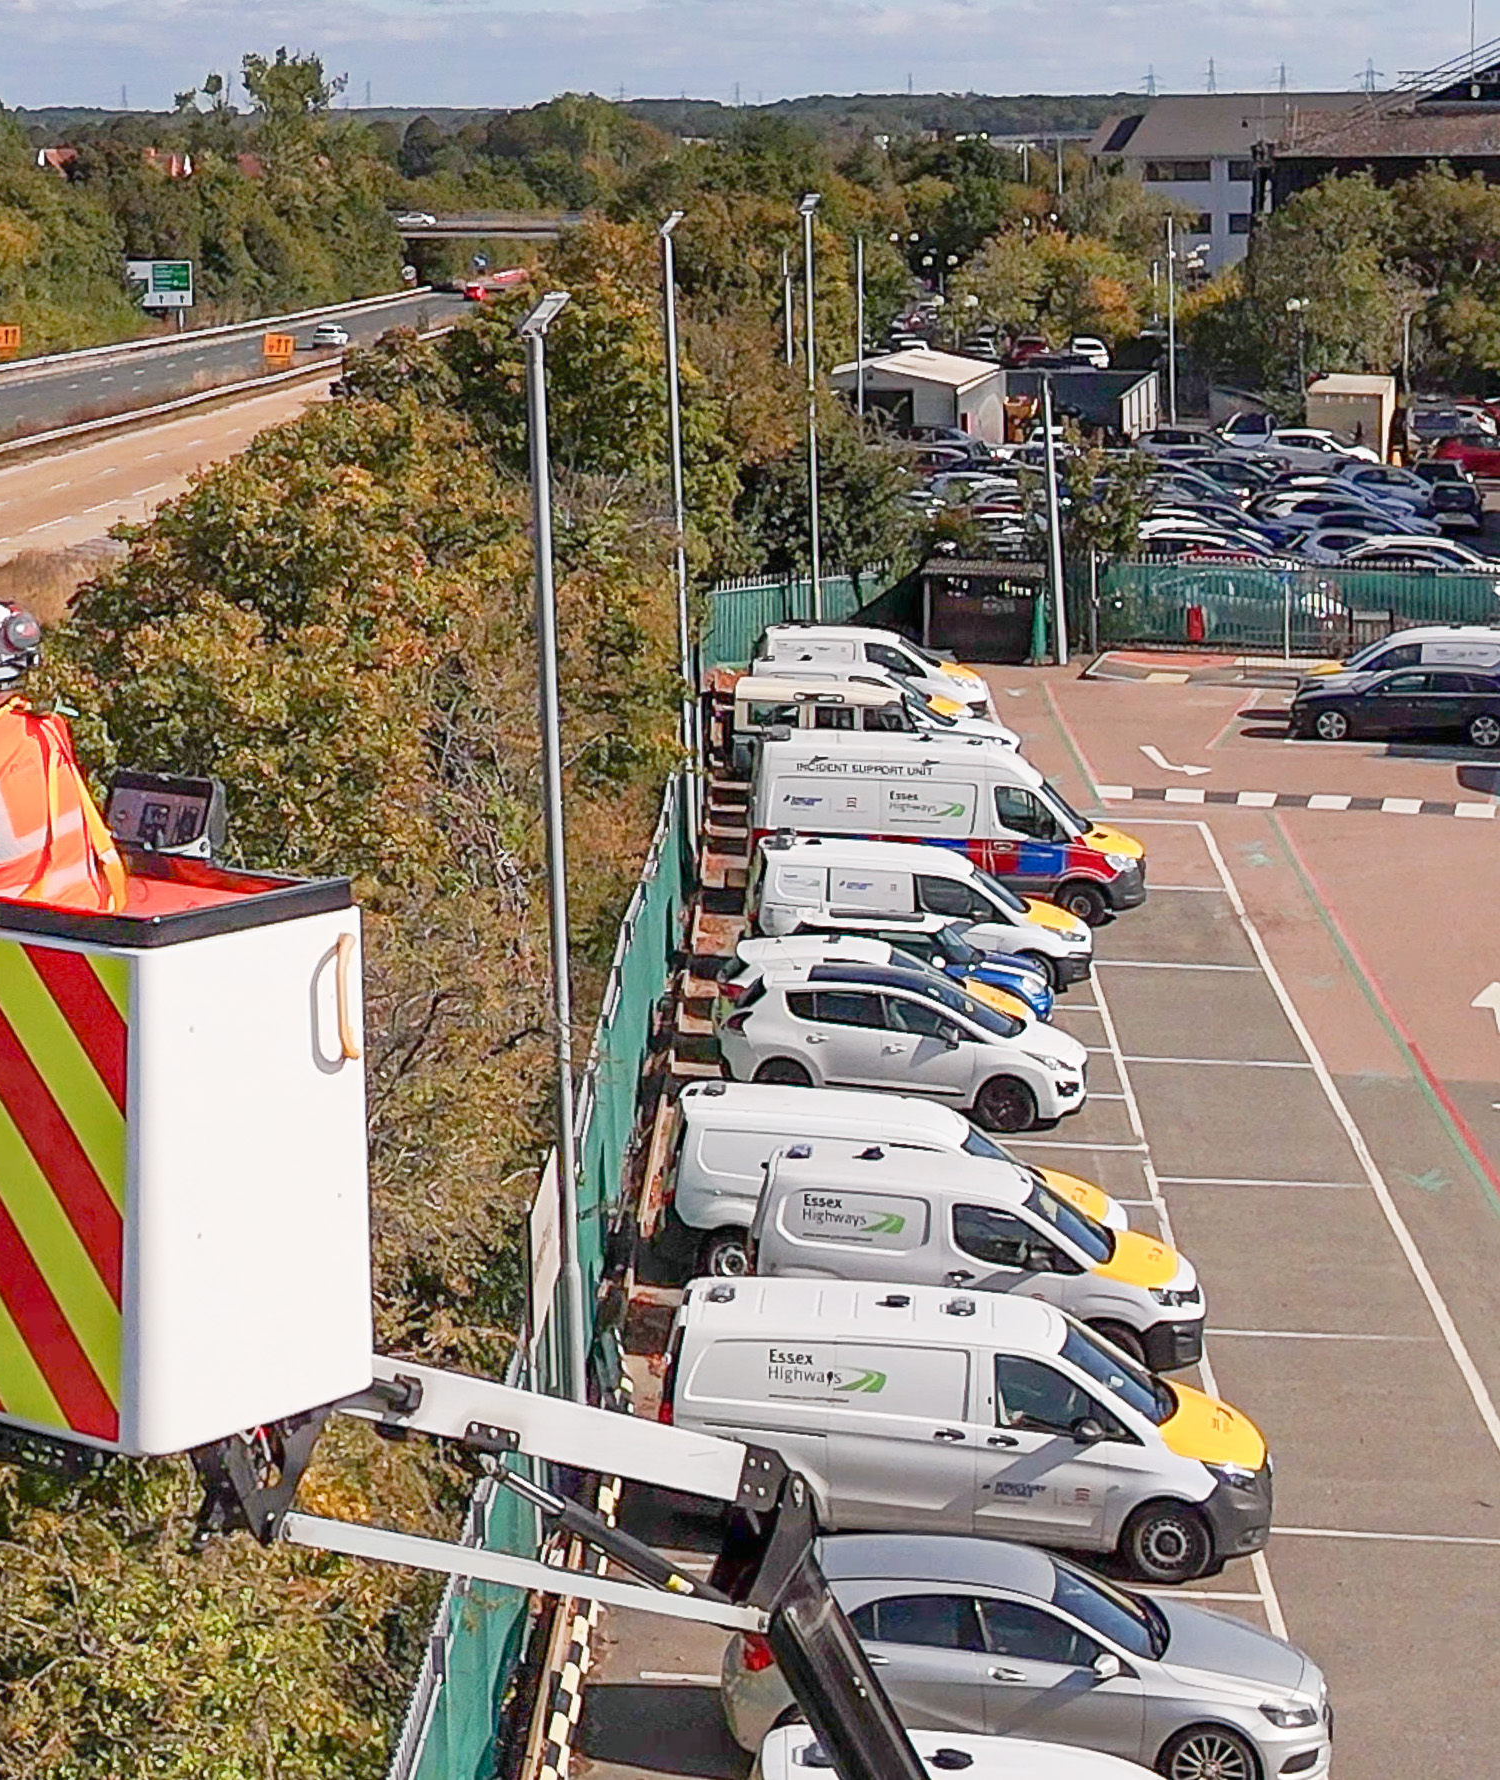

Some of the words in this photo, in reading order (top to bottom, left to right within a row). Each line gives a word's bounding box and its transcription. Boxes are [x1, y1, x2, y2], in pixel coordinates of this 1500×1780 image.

[803, 1193, 843, 1209] Essex
[802, 1208, 867, 1228] Highways
[769, 1348, 814, 1366] Essex
[768, 1365, 843, 1388] Highways
